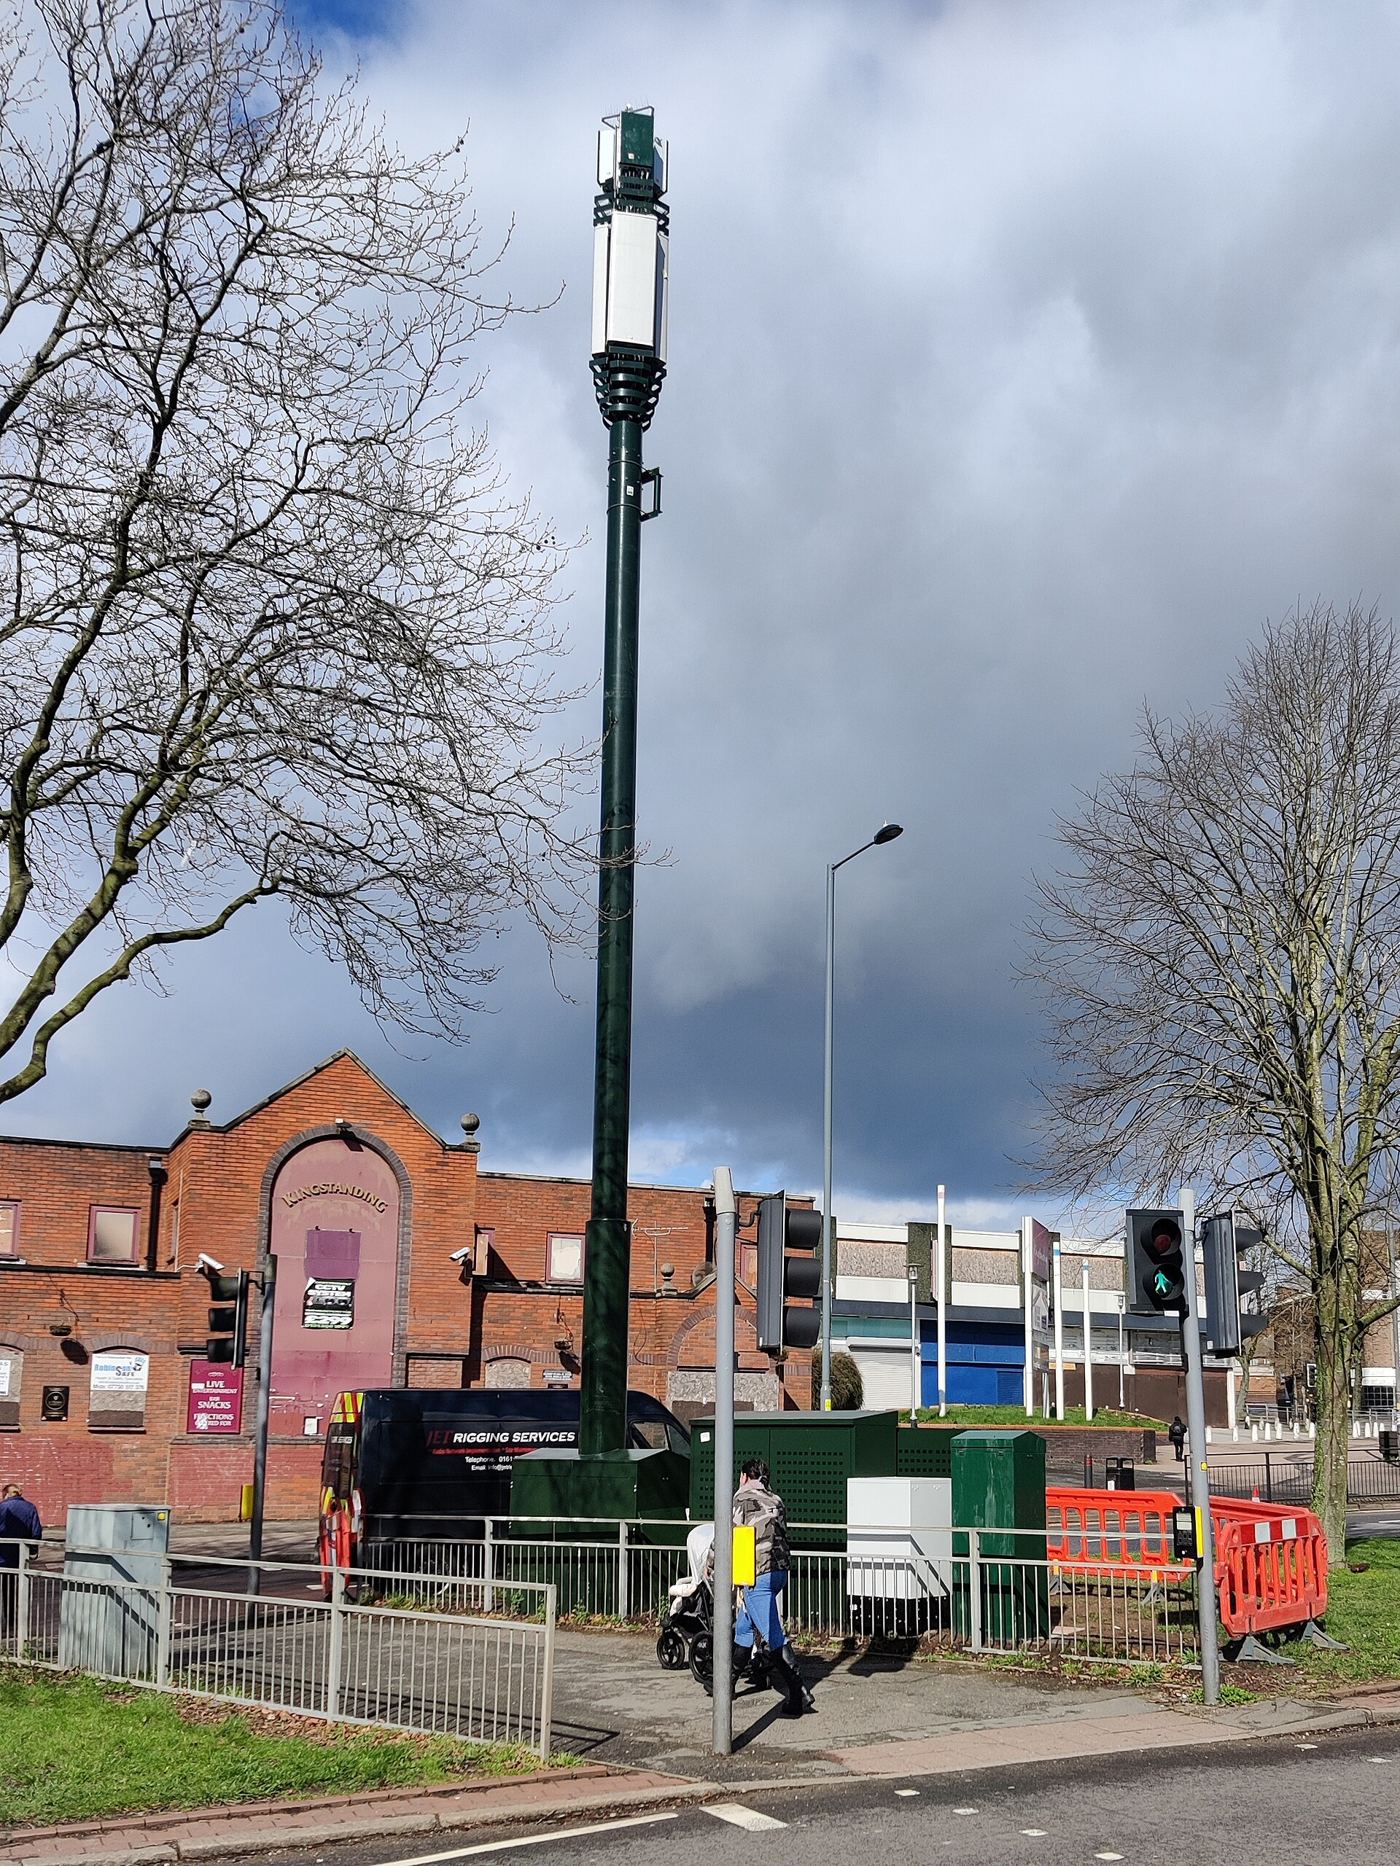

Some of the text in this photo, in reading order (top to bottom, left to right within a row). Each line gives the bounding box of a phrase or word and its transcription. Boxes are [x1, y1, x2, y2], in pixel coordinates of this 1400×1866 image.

[282, 1183, 388, 1213] KINGSTANDING
[206, 1380, 226, 1388] LIVE
[197, 1401, 232, 1409] SNACKS
[426, 1429, 576, 1446] JET RIGGING SERVICES
